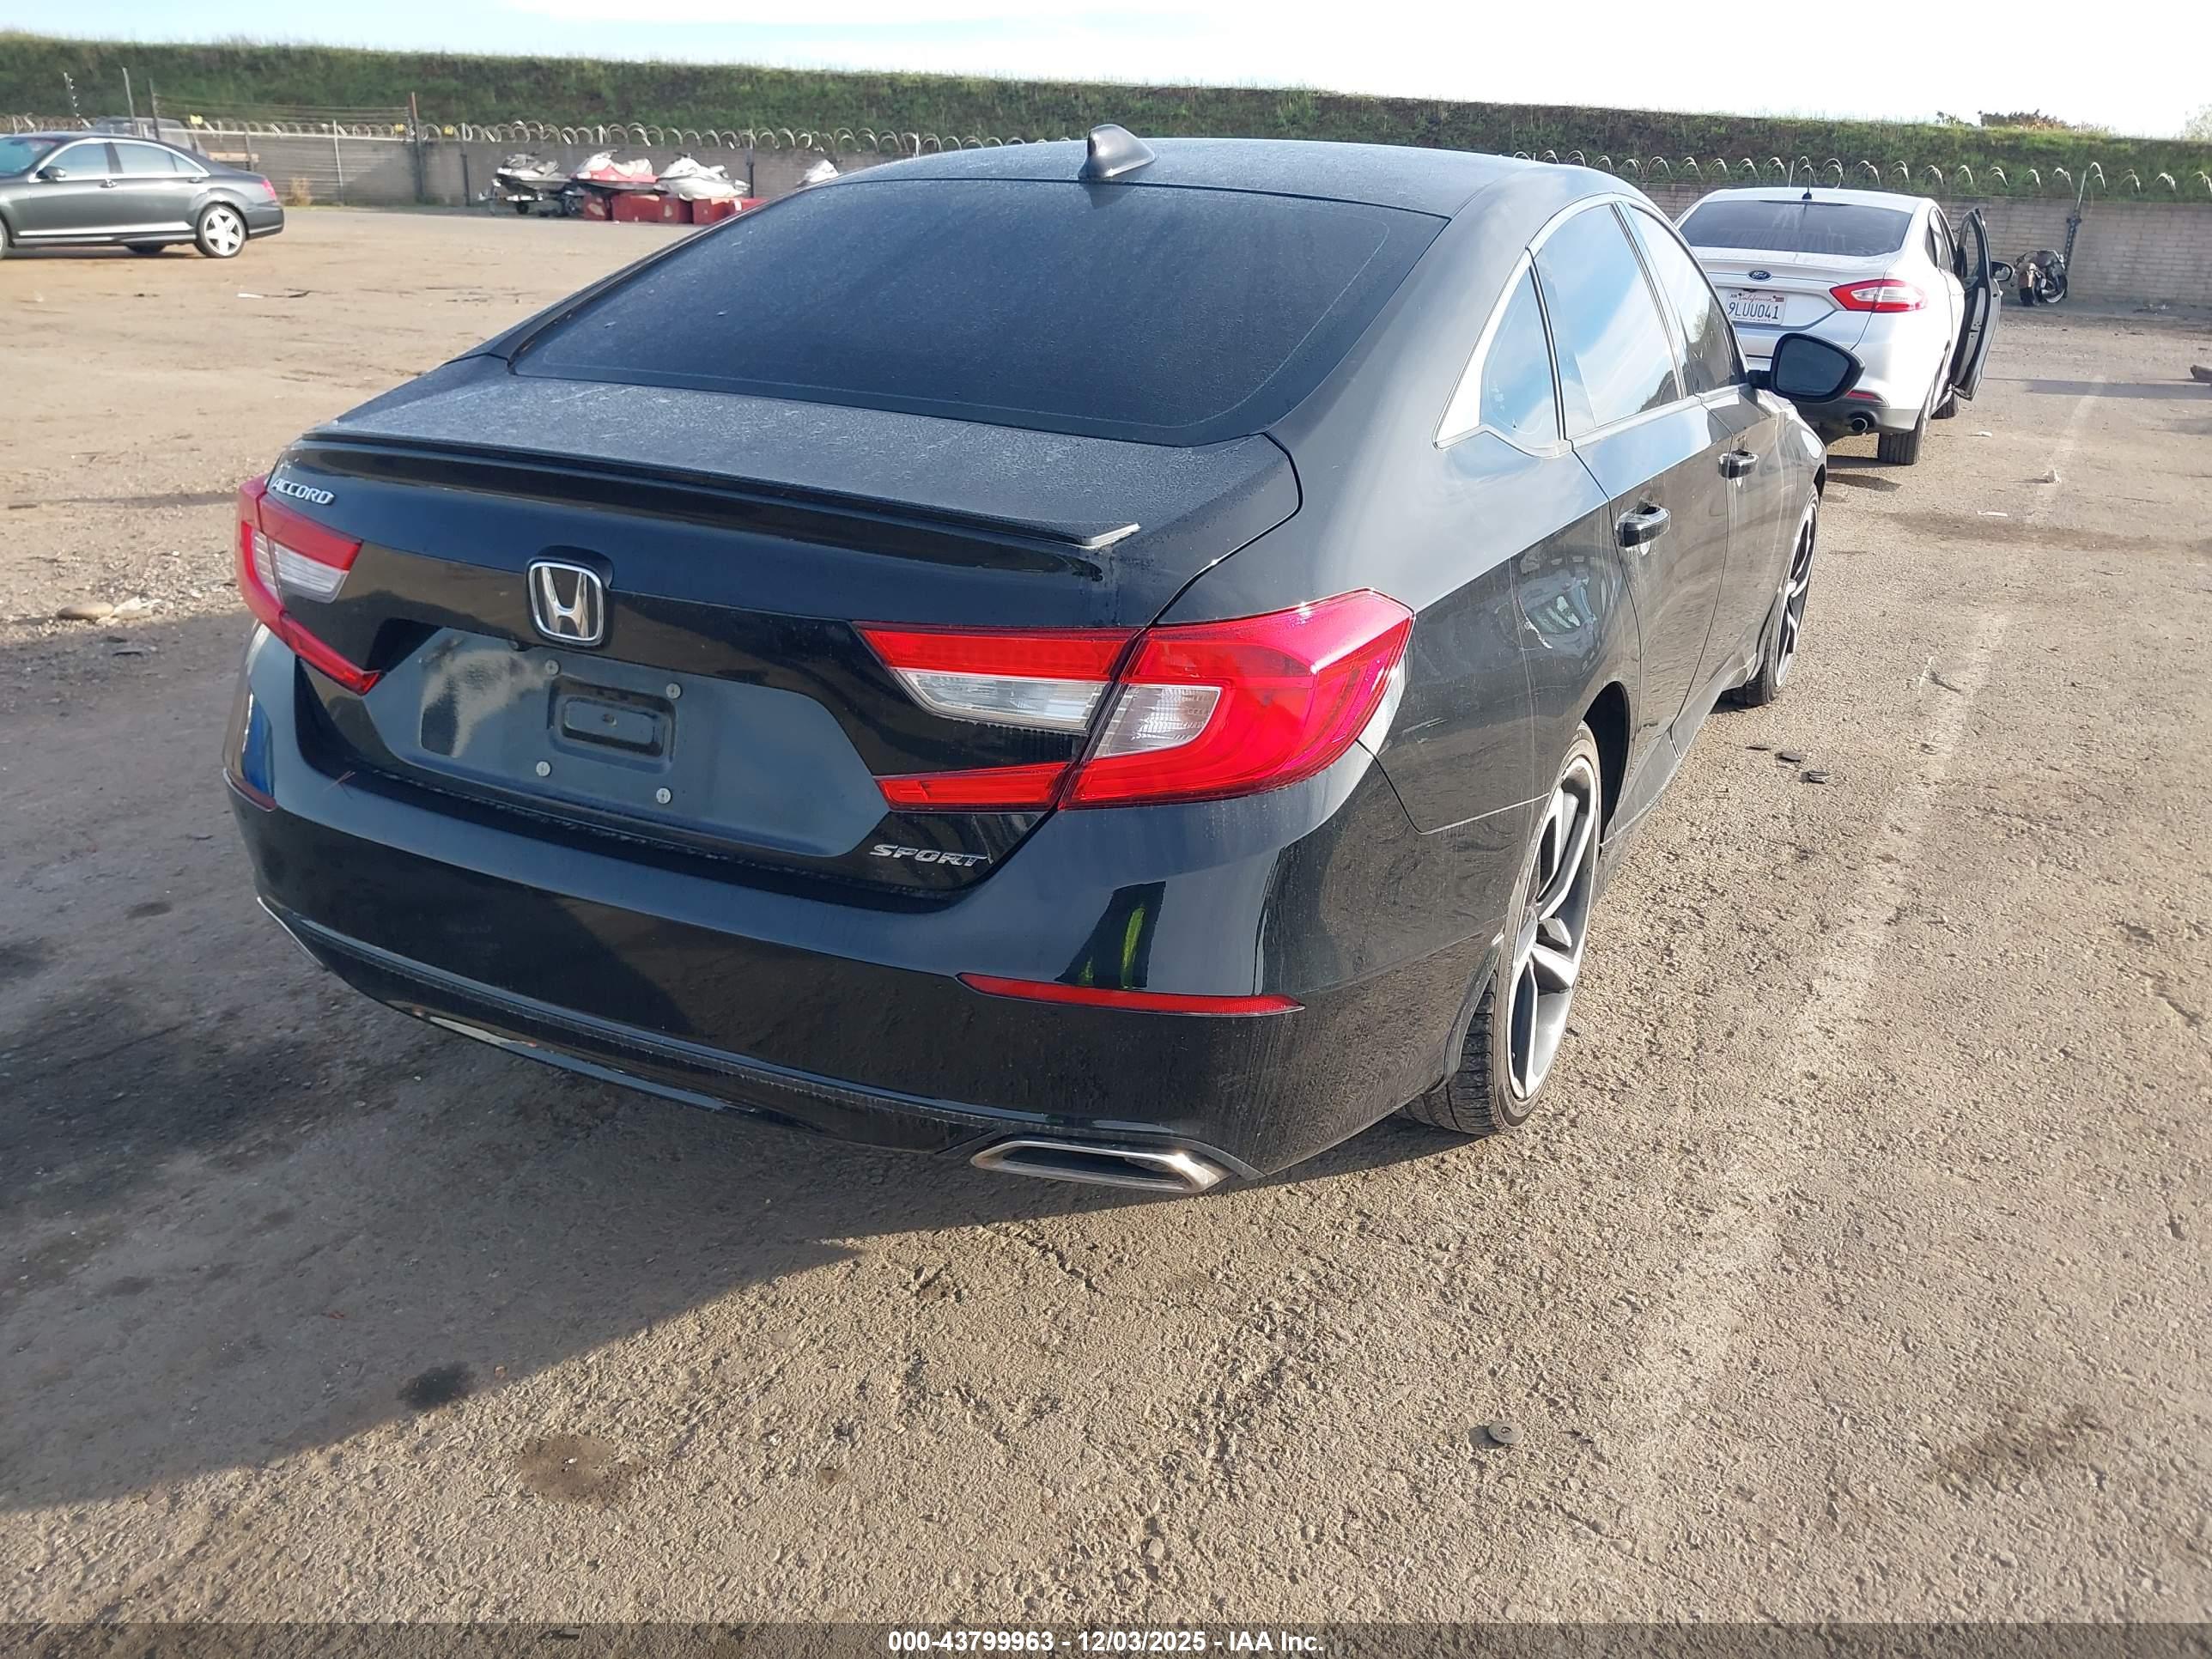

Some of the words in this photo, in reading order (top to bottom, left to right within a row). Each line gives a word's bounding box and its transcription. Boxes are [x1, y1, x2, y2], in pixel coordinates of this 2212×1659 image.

[1728, 301, 1779, 319] 9LUU041
[270, 477, 335, 505] ACCORD
[869, 843, 988, 867] SPORT
